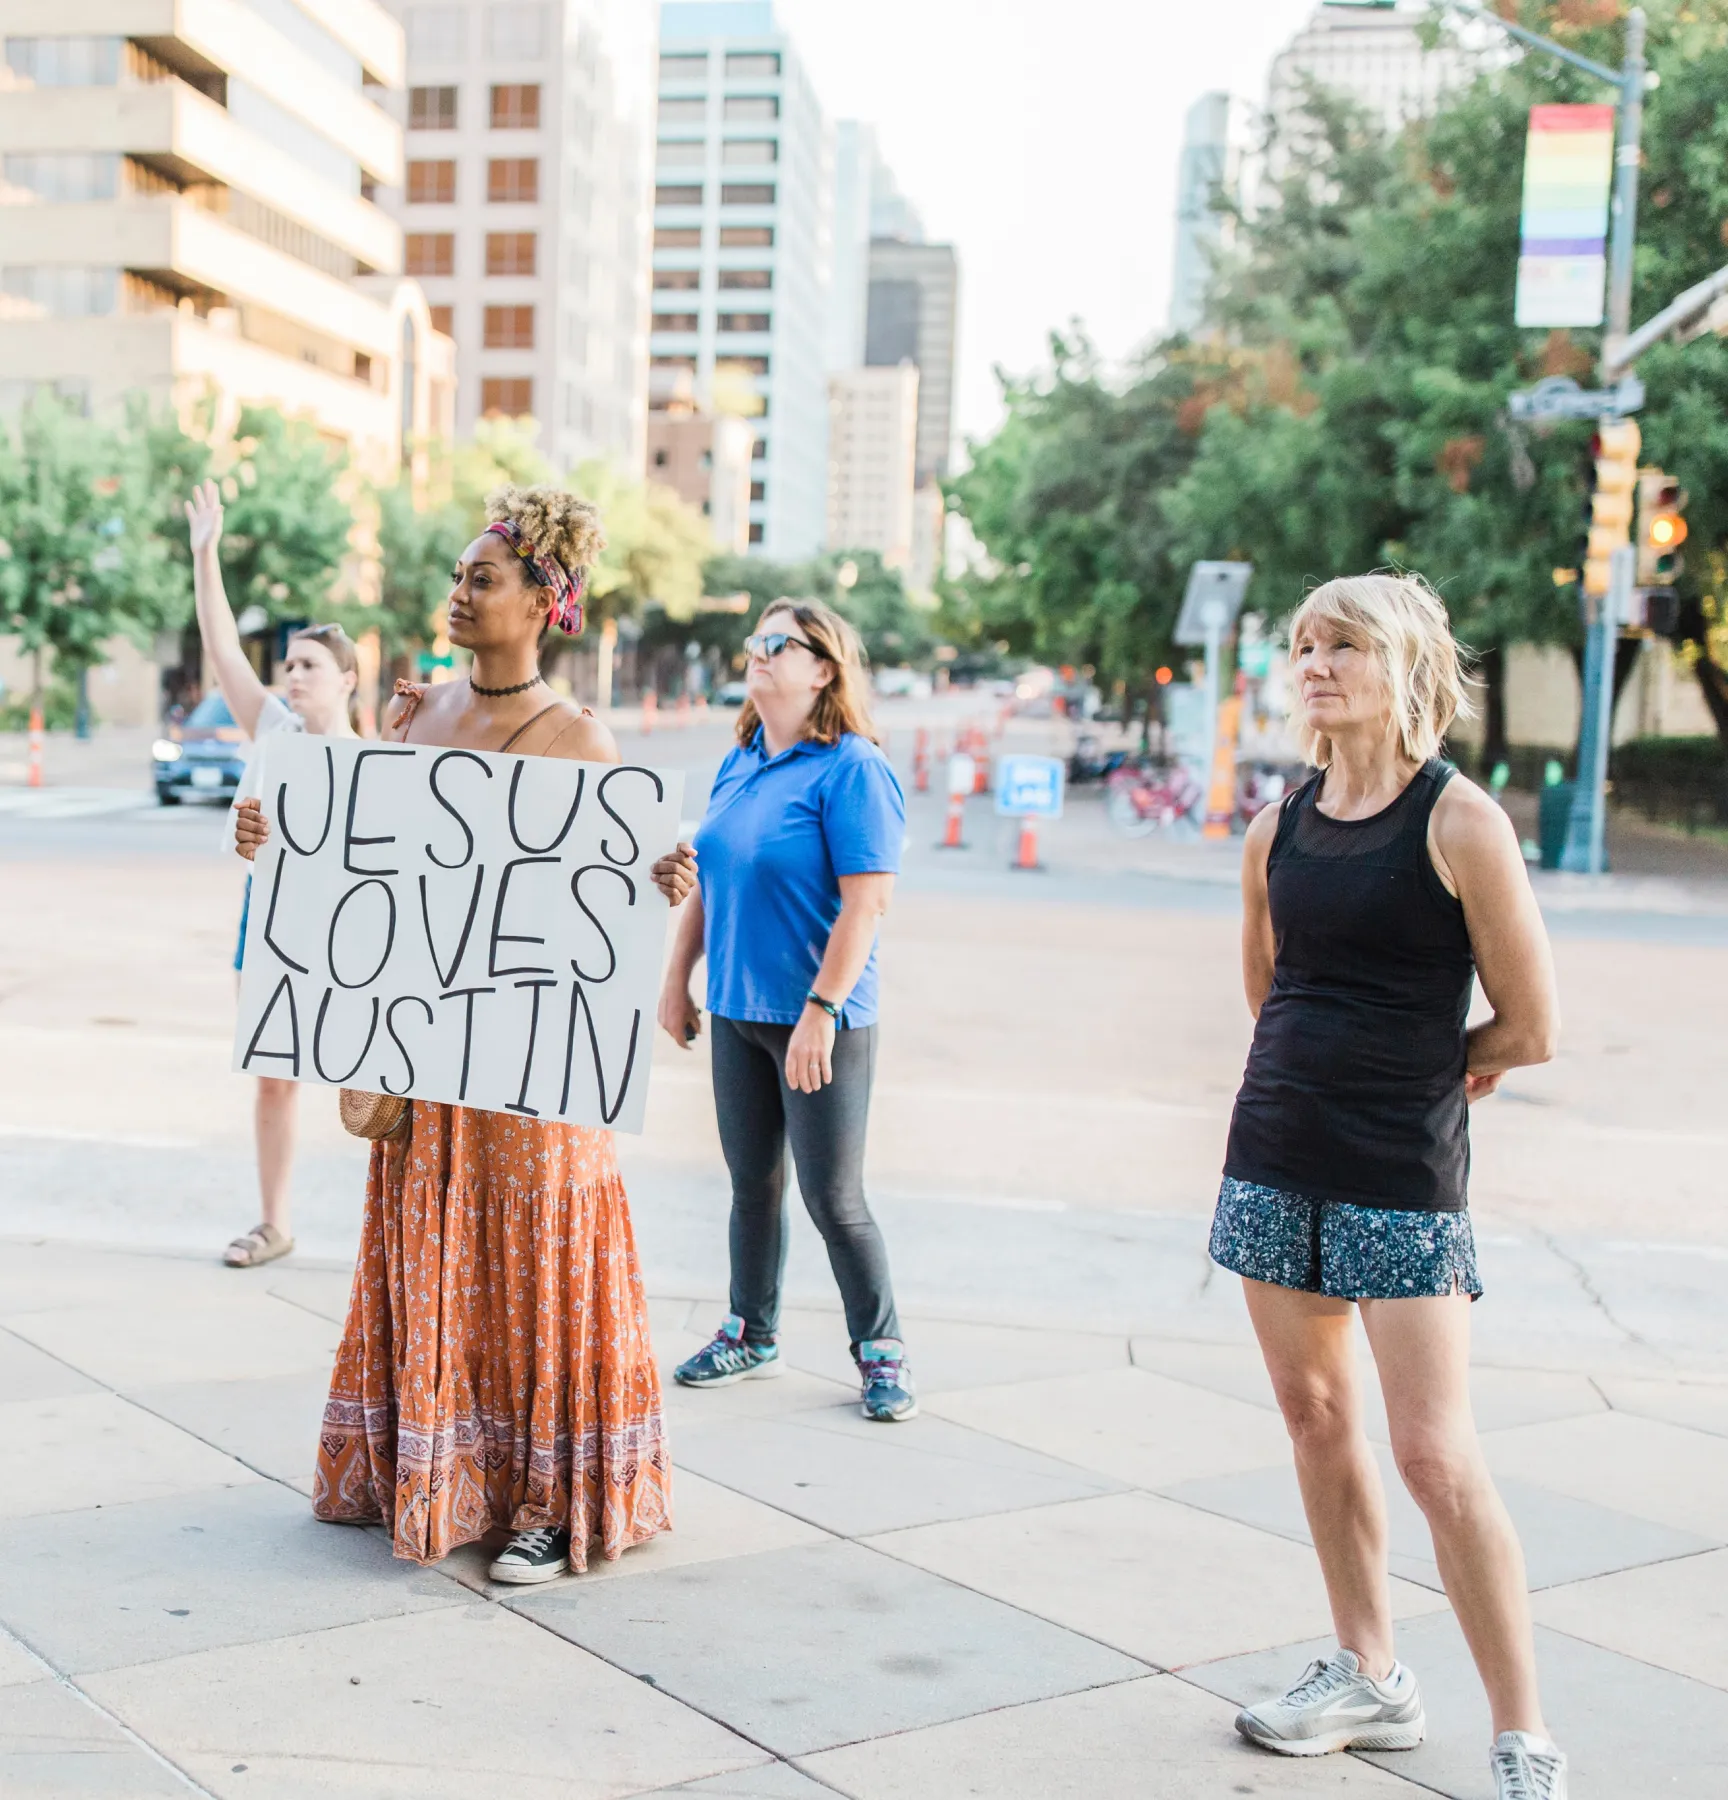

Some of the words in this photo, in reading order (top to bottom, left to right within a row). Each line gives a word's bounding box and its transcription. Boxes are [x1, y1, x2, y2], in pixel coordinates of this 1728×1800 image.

[277, 746, 664, 875] JESUS
[264, 847, 637, 989] LOVES
[241, 973, 641, 1124] AUSTIN
